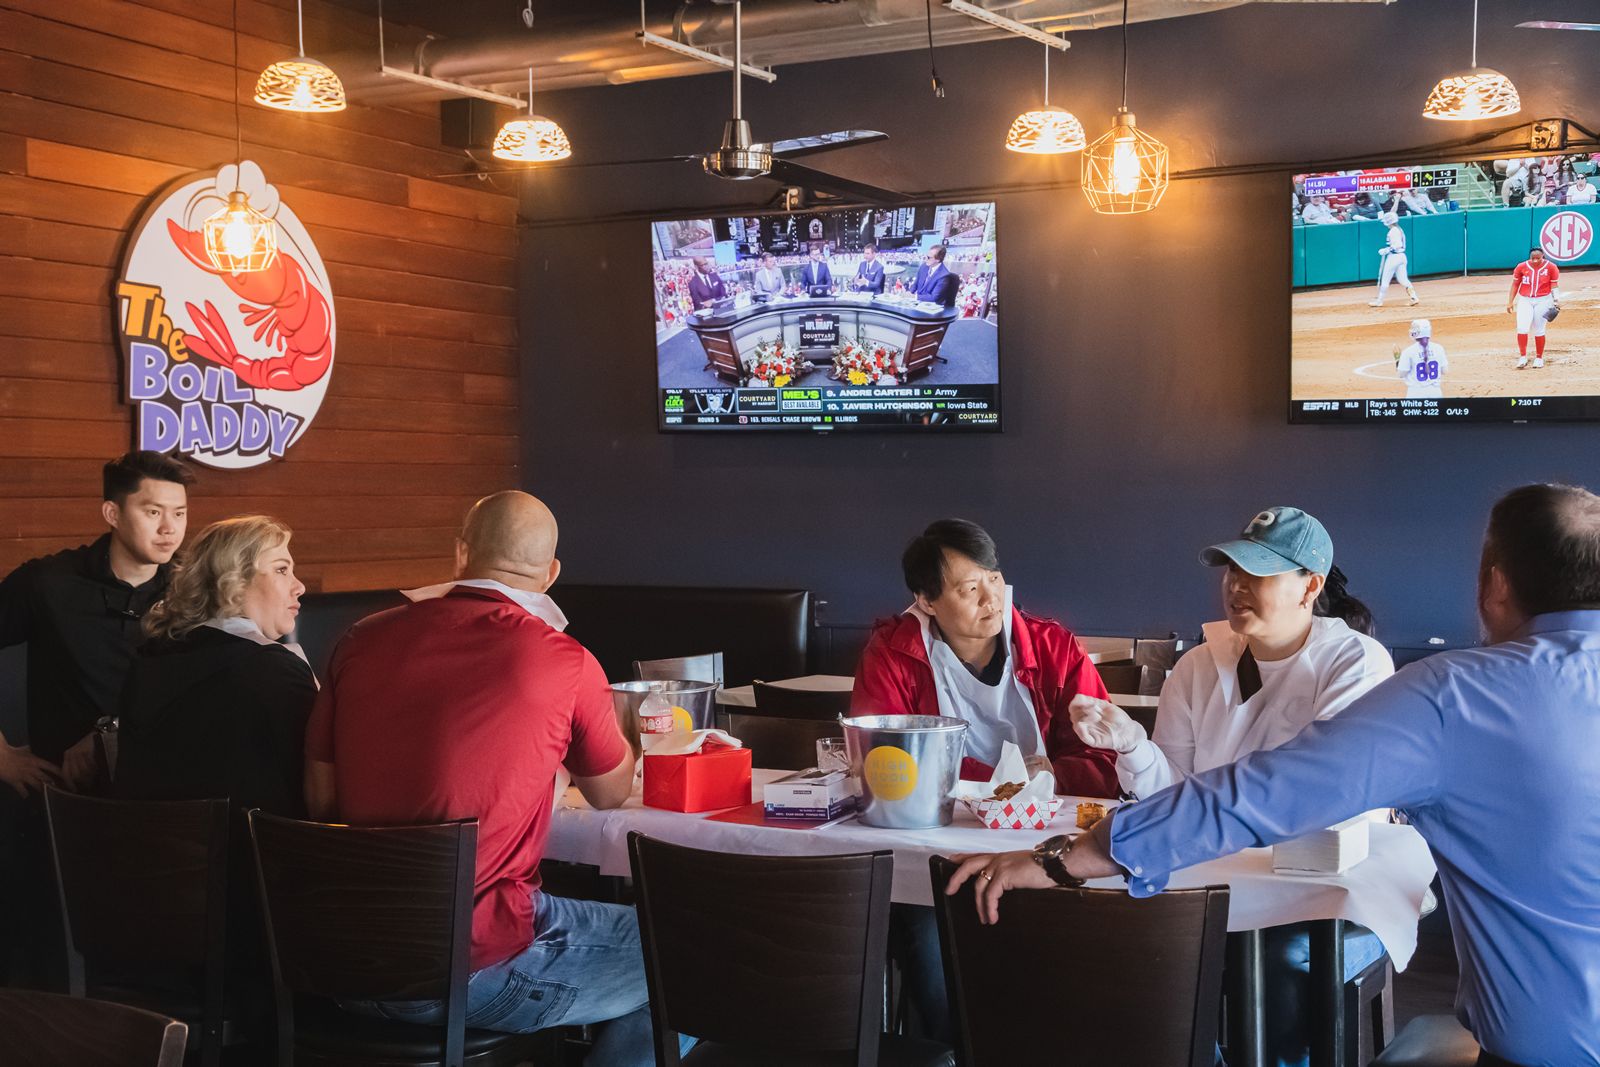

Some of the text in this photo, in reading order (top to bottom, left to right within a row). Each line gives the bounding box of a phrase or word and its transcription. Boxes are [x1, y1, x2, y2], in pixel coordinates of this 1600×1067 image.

[1543, 215, 1589, 257] SEC
[118, 282, 188, 361] The
[130, 342, 253, 403] BOIL
[1416, 360, 1438, 382] 88
[665, 399, 684, 407] CLOCK
[782, 390, 820, 399] MEL'S
[934, 389, 958, 397] Army
[1369, 400, 1387, 409] Rays
[140, 400, 299, 456] DADDY
